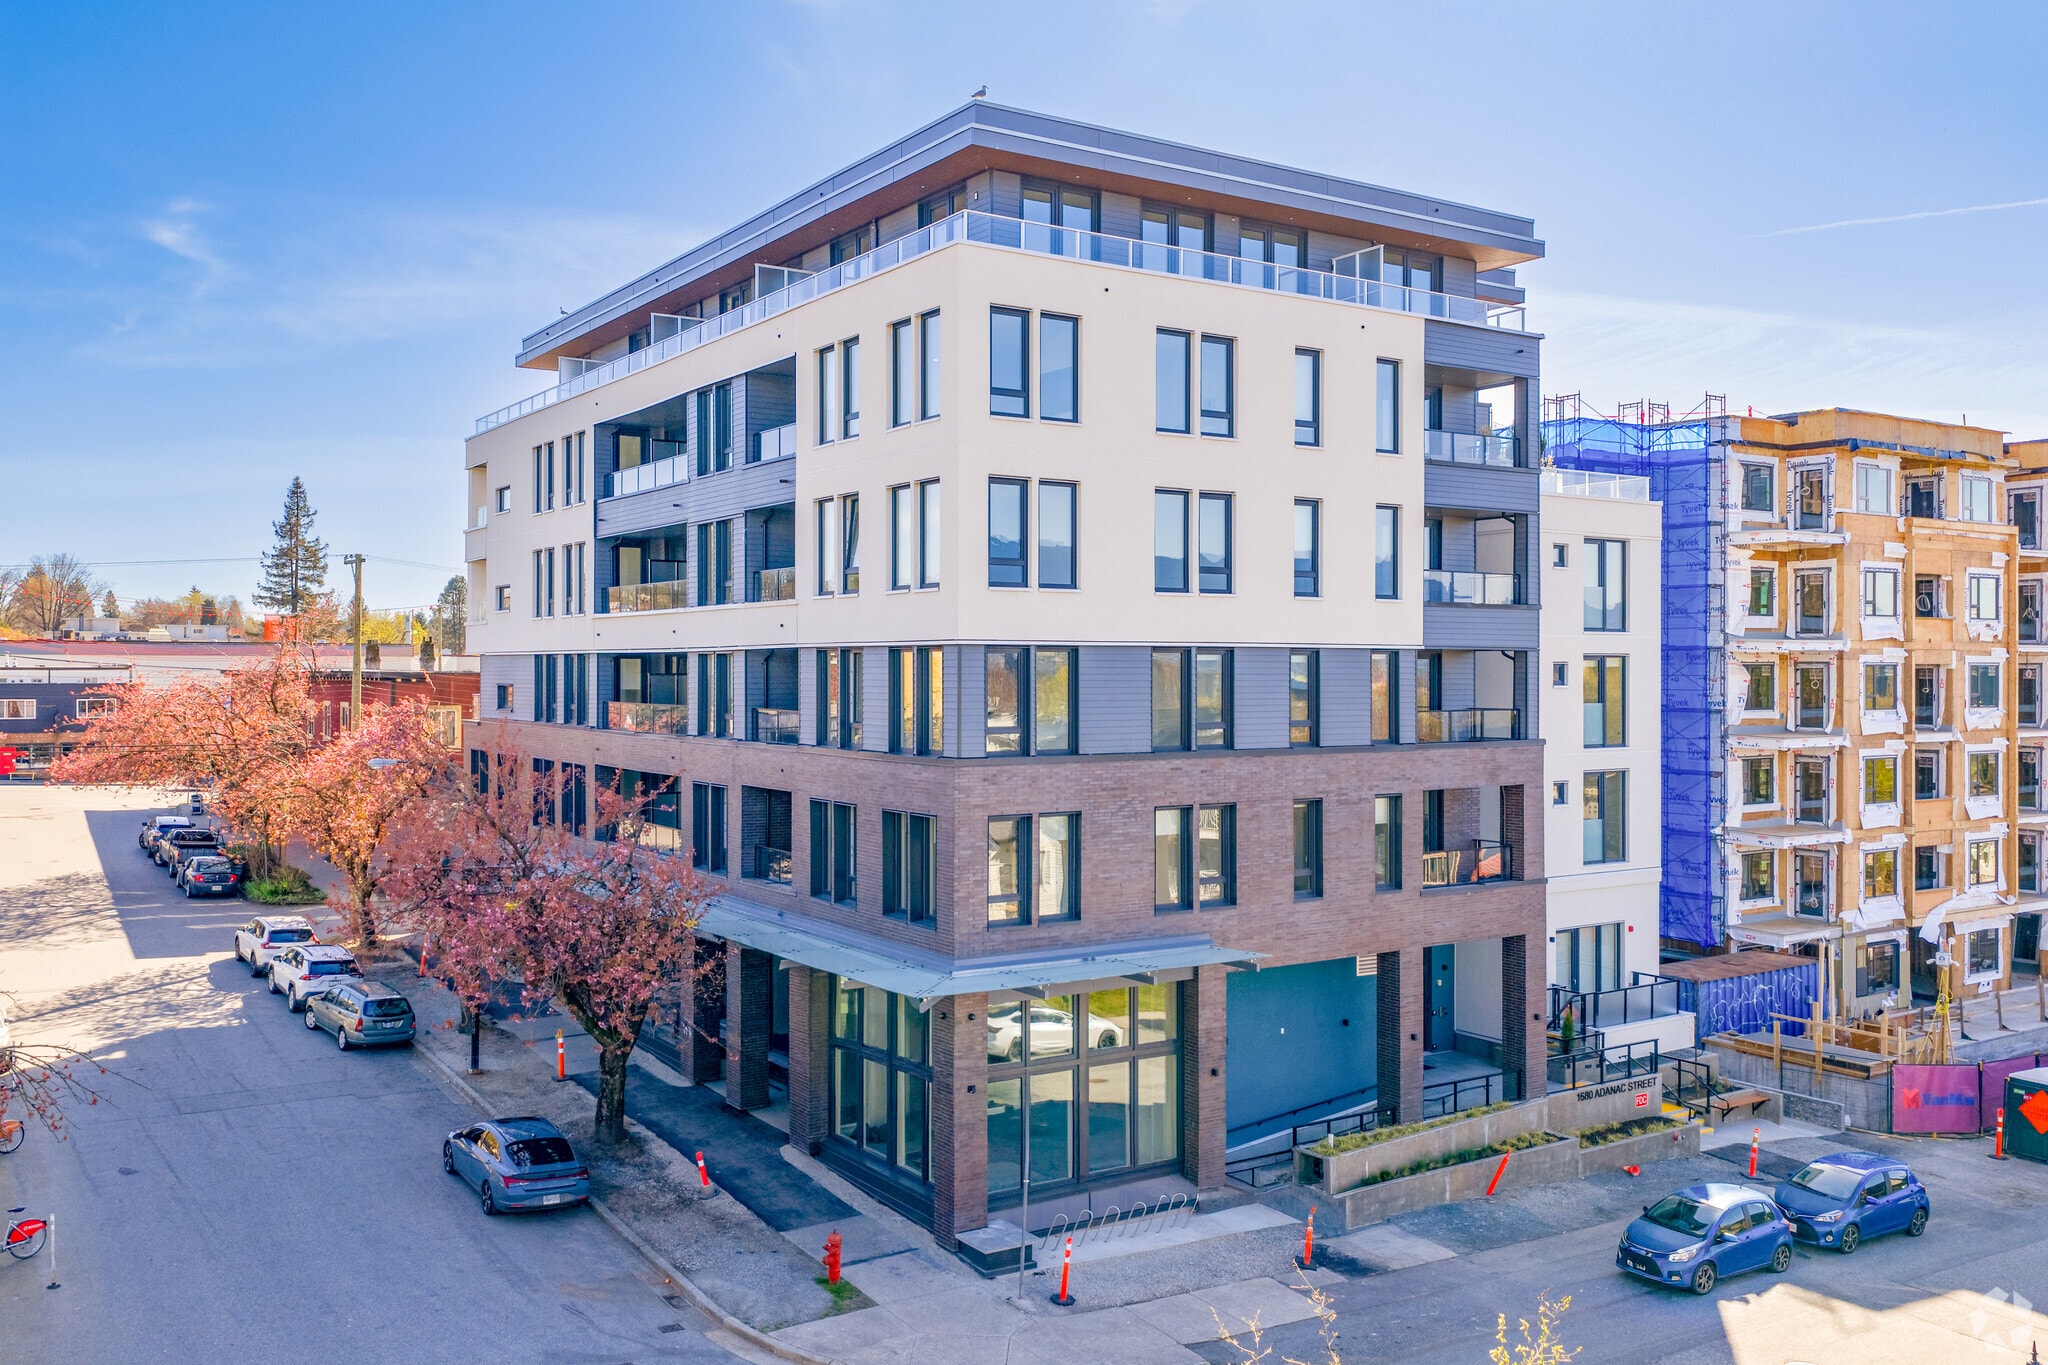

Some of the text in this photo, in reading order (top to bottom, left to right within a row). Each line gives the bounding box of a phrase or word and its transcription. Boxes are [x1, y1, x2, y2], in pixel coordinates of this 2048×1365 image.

[1681, 504, 1705, 514] Tyvek
[1677, 538, 1699, 548] Tyvek
[1725, 559, 1742, 567] yvek
[1668, 698, 1689, 708] Tyvek
[1708, 700, 1727, 708] yvek
[1681, 861, 1703, 873] Tyvek
[1577, 1077, 1658, 1102] 1680 ADANAC STREET
[1636, 1095, 1647, 1104] FDC
